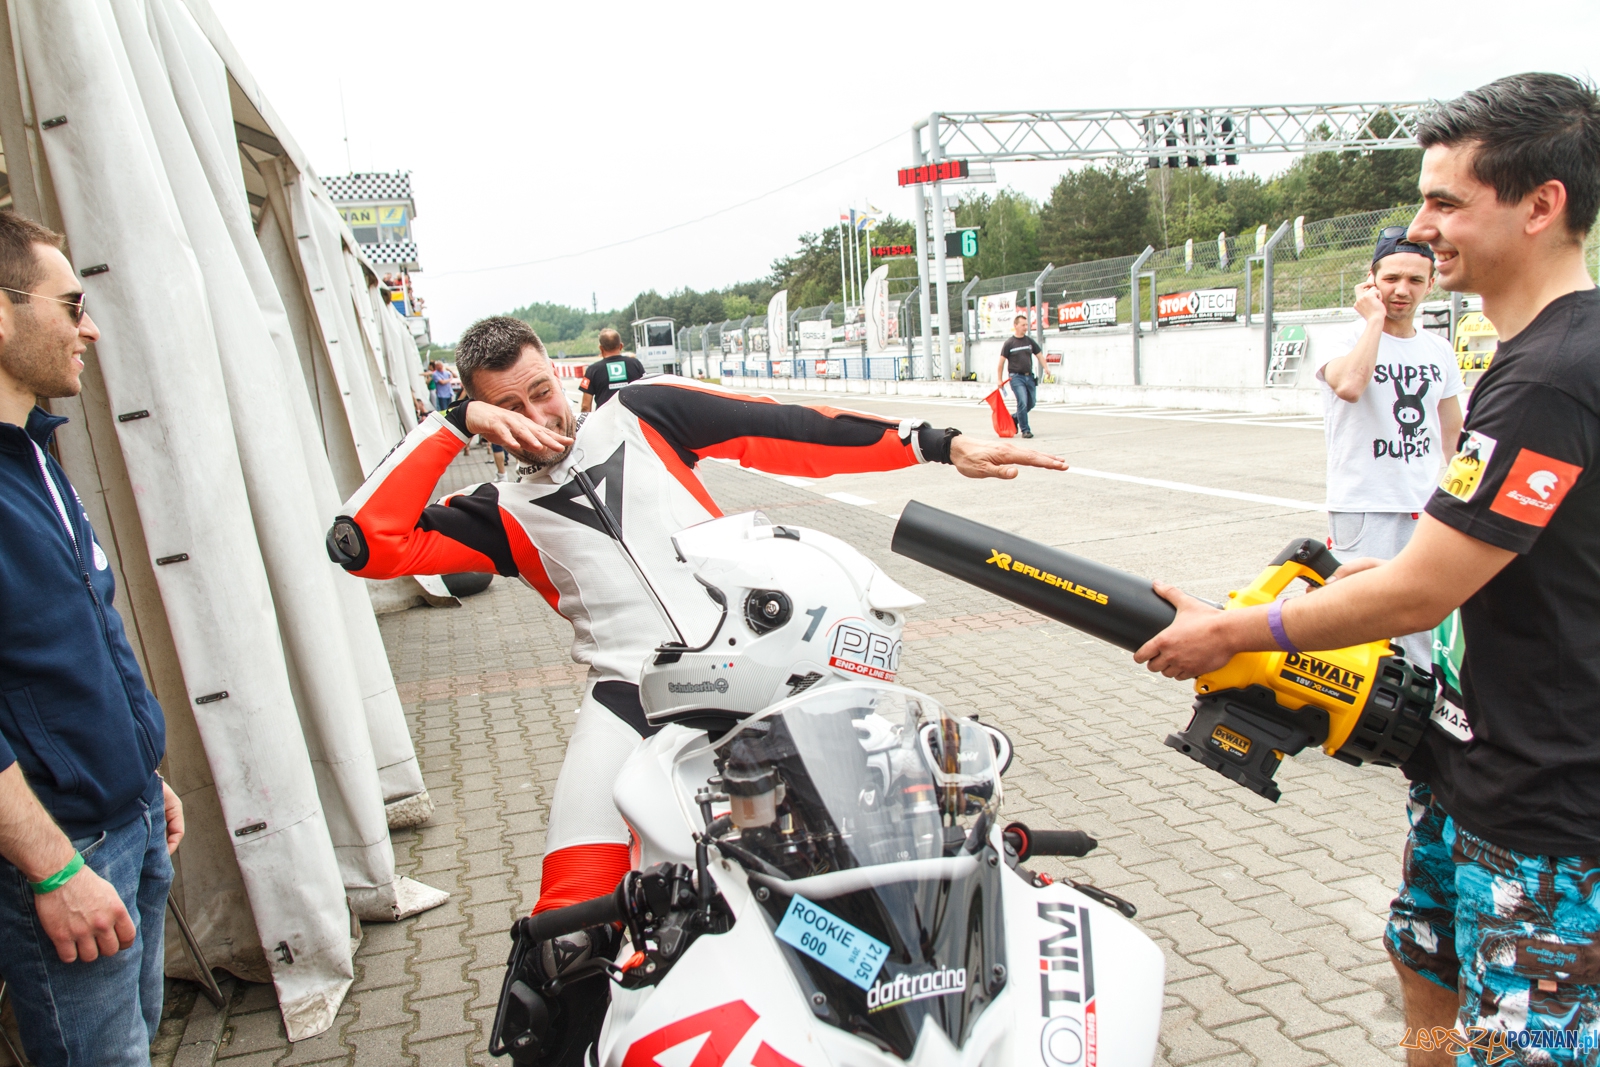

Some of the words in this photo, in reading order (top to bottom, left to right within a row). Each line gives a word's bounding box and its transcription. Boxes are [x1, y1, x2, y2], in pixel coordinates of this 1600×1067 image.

[871, 245, 912, 257] 14:15:34
[962, 230, 977, 257] 6
[1060, 306, 1082, 321] STOP
[1091, 303, 1114, 316] TECH
[1160, 300, 1187, 314] STOP
[1201, 294, 1235, 308] TECH
[611, 364, 623, 376] D
[1374, 363, 1442, 388] SUPER
[985, 548, 1012, 571] XR
[1011, 560, 1109, 606] BRUSHLESS
[801, 605, 828, 642] 1
[834, 659, 868, 674] END-OF
[868, 668, 884, 679] LINE
[792, 902, 855, 948] ROOKIE
[800, 931, 828, 957] 600
[867, 964, 967, 1009] daftracing
